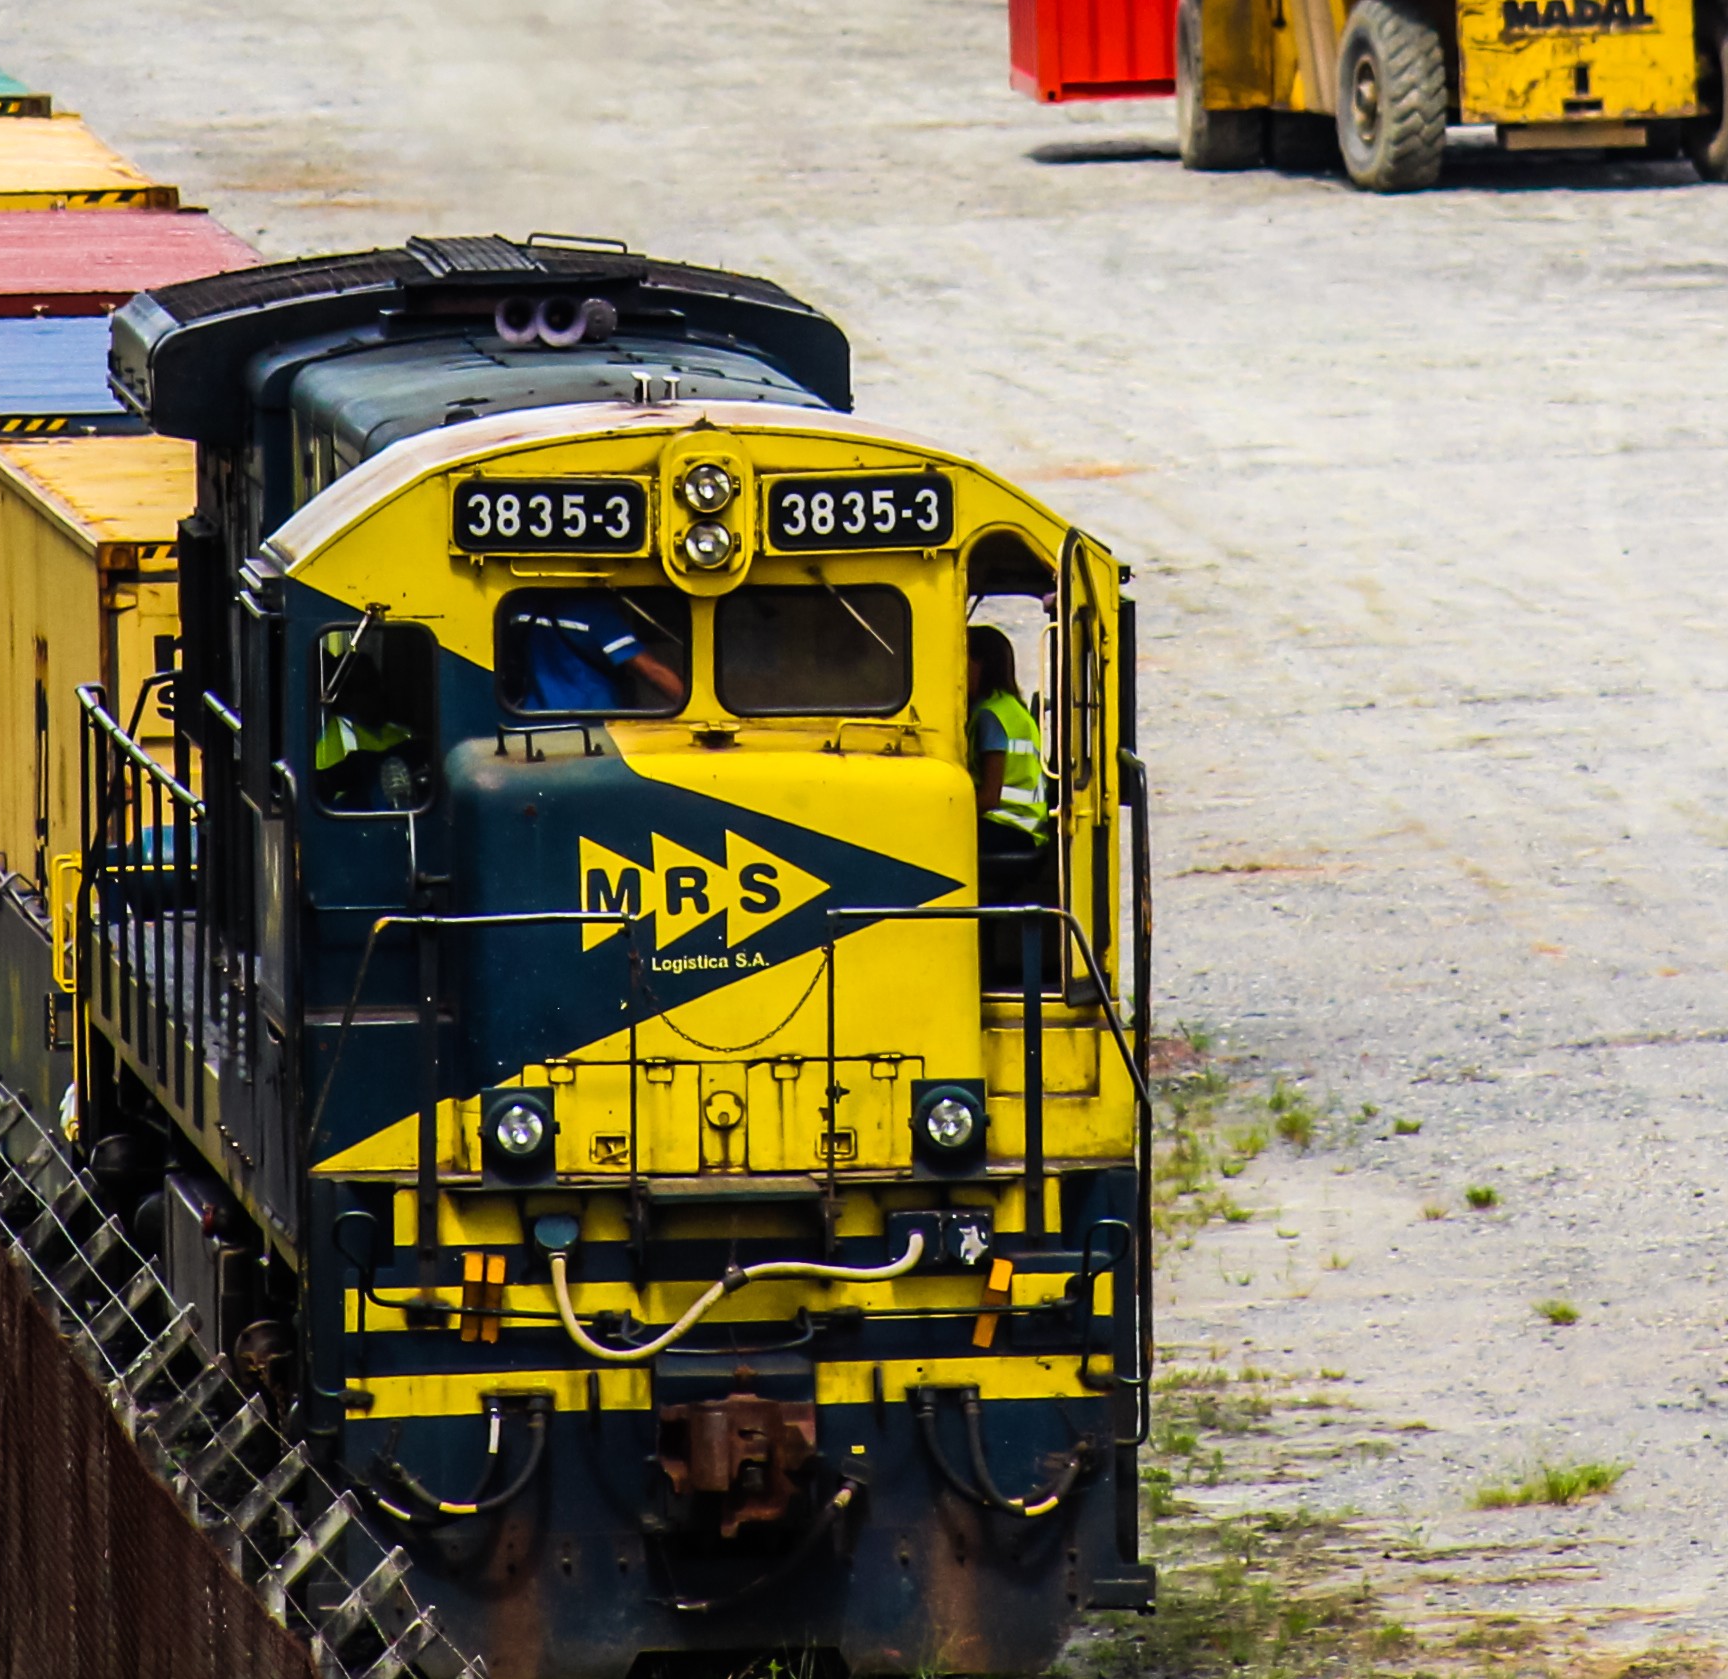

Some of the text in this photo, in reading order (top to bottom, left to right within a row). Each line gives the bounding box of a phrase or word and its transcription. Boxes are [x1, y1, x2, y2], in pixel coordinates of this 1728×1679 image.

[467, 493, 632, 539] 3835-3
[781, 488, 940, 537] 3835-3
[586, 862, 781, 917] MRS
[651, 952, 770, 974] Logistica S.A.
